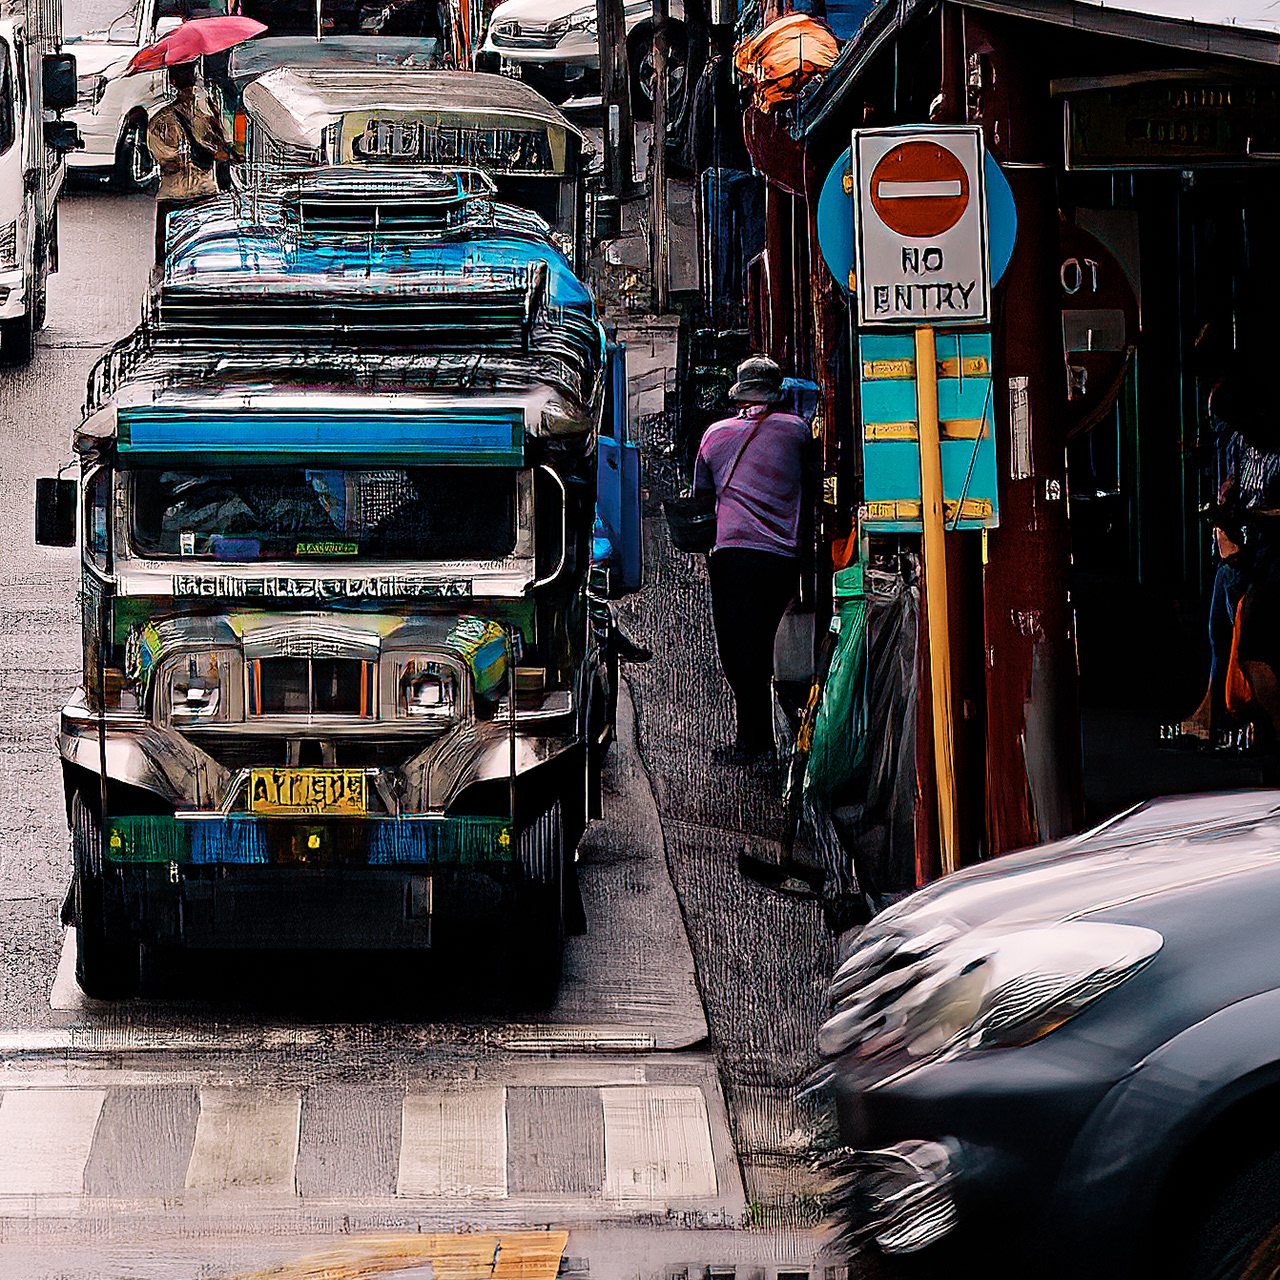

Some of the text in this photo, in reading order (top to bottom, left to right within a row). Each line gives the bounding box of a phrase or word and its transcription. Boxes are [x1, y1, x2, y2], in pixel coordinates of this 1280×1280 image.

[901, 246, 943, 275] NO
[1060, 257, 1098, 295] OT
[873, 281, 976, 314] ENTRY
